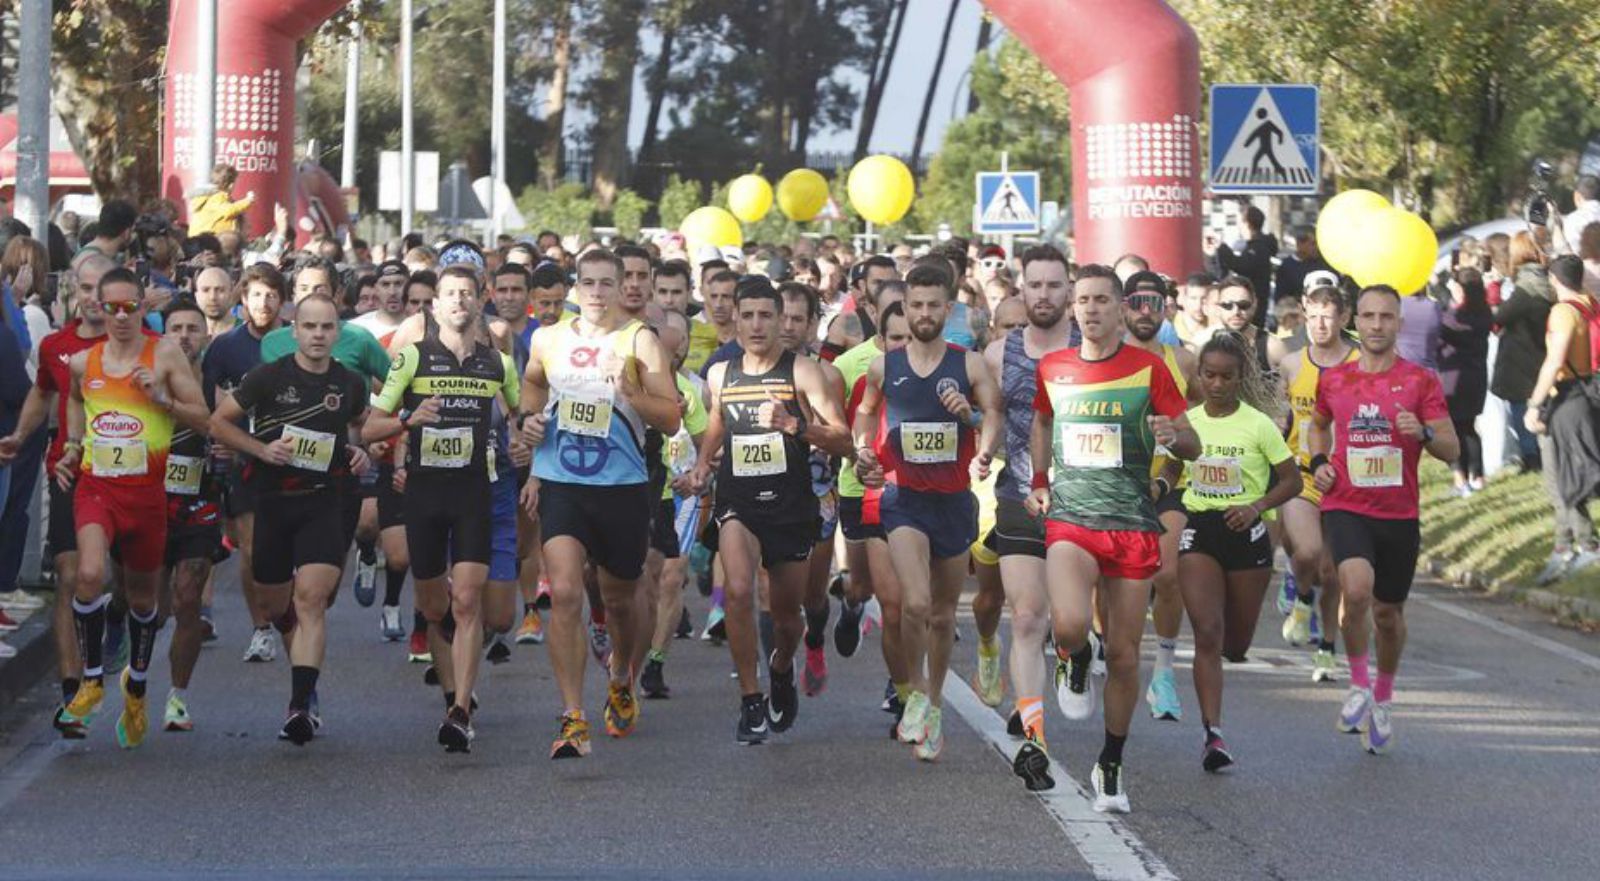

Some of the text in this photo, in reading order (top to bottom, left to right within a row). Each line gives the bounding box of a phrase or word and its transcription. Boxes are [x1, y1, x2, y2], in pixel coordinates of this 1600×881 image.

[1087, 182, 1193, 203] DEPUTACIÓN
[1087, 201, 1194, 220] PONTEVEDRA
[429, 378, 489, 391] LOURIÑA
[570, 402, 596, 423] 199
[97, 417, 139, 432] Serrano
[297, 437, 317, 458] 114
[432, 437, 463, 456] 430
[914, 432, 945, 451] 328
[1077, 434, 1104, 455] 712
[1349, 434, 1364, 443] LOS
[112, 446, 123, 465] 2
[742, 444, 772, 464] 226
[1199, 464, 1228, 484] 706
[1364, 457, 1384, 475] 711
